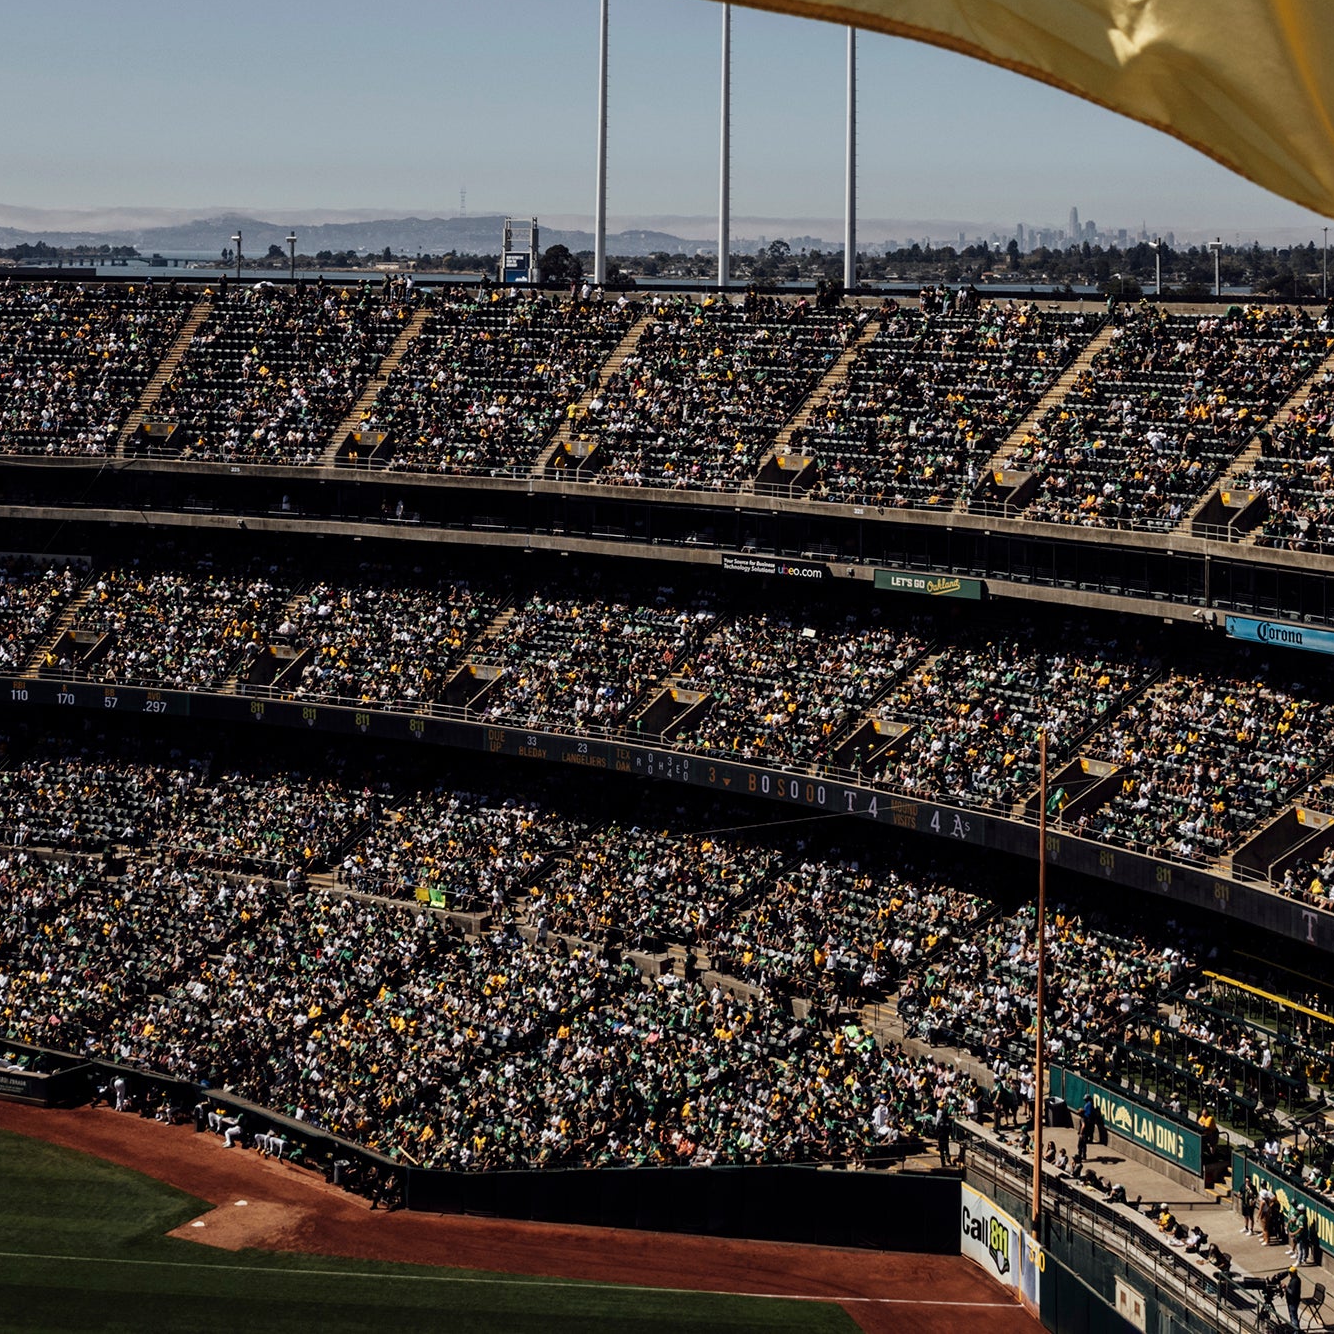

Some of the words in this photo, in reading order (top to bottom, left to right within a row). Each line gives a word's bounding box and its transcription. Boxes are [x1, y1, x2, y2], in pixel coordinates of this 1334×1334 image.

[756, 560, 775, 568] Business
[778, 564, 822, 578] ubeo.com
[891, 576, 913, 588] LET'S
[914, 579, 925, 589] GO
[927, 577, 961, 595] Oakland
[1257, 621, 1303, 645] Corona
[11, 689, 28, 701] 110
[57, 692, 75, 705] 170
[104, 697, 118, 708] 57
[142, 700, 167, 713] .297
[250, 702, 264, 714] 811
[302, 707, 317, 720] 811
[355, 713, 370, 725] 811
[409, 718, 424, 732] 811
[488, 729, 506, 741] DUE
[490, 741, 502, 752] UP
[527, 735, 537, 746] 33
[578, 743, 588, 754] 23
[519, 745, 547, 759] BLEDAY
[562, 752, 607, 767] LANGELIERS
[616, 748, 631, 760] TEX
[648, 753, 654, 763] 0
[683, 760, 689, 770] 0
[616, 760, 632, 773] OAK
[648, 765, 653, 775] 0
[683, 772, 688, 782] 0
[659, 761, 664, 771] H
[709, 767, 716, 783] 3
[749, 772, 757, 792] B
[761, 775, 770, 794] 0
[777, 778, 786, 797] S
[790, 780, 799, 800] 0
[817, 786, 826, 805] 0
[868, 796, 878, 818] 4
[891, 799, 918, 816] MOUND
[892, 813, 916, 827] VISITS
[930, 810, 940, 833] 4
[1047, 835, 1060, 851] 811
[1100, 849, 1114, 867] 811
[1156, 866, 1172, 884] 811
[1214, 882, 1230, 901] 811
[1093, 1093, 1116, 1125] OAK
[1134, 1113, 1184, 1159] LANDING
[963, 1206, 989, 1247] Call
[990, 1216, 1009, 1263] 811
